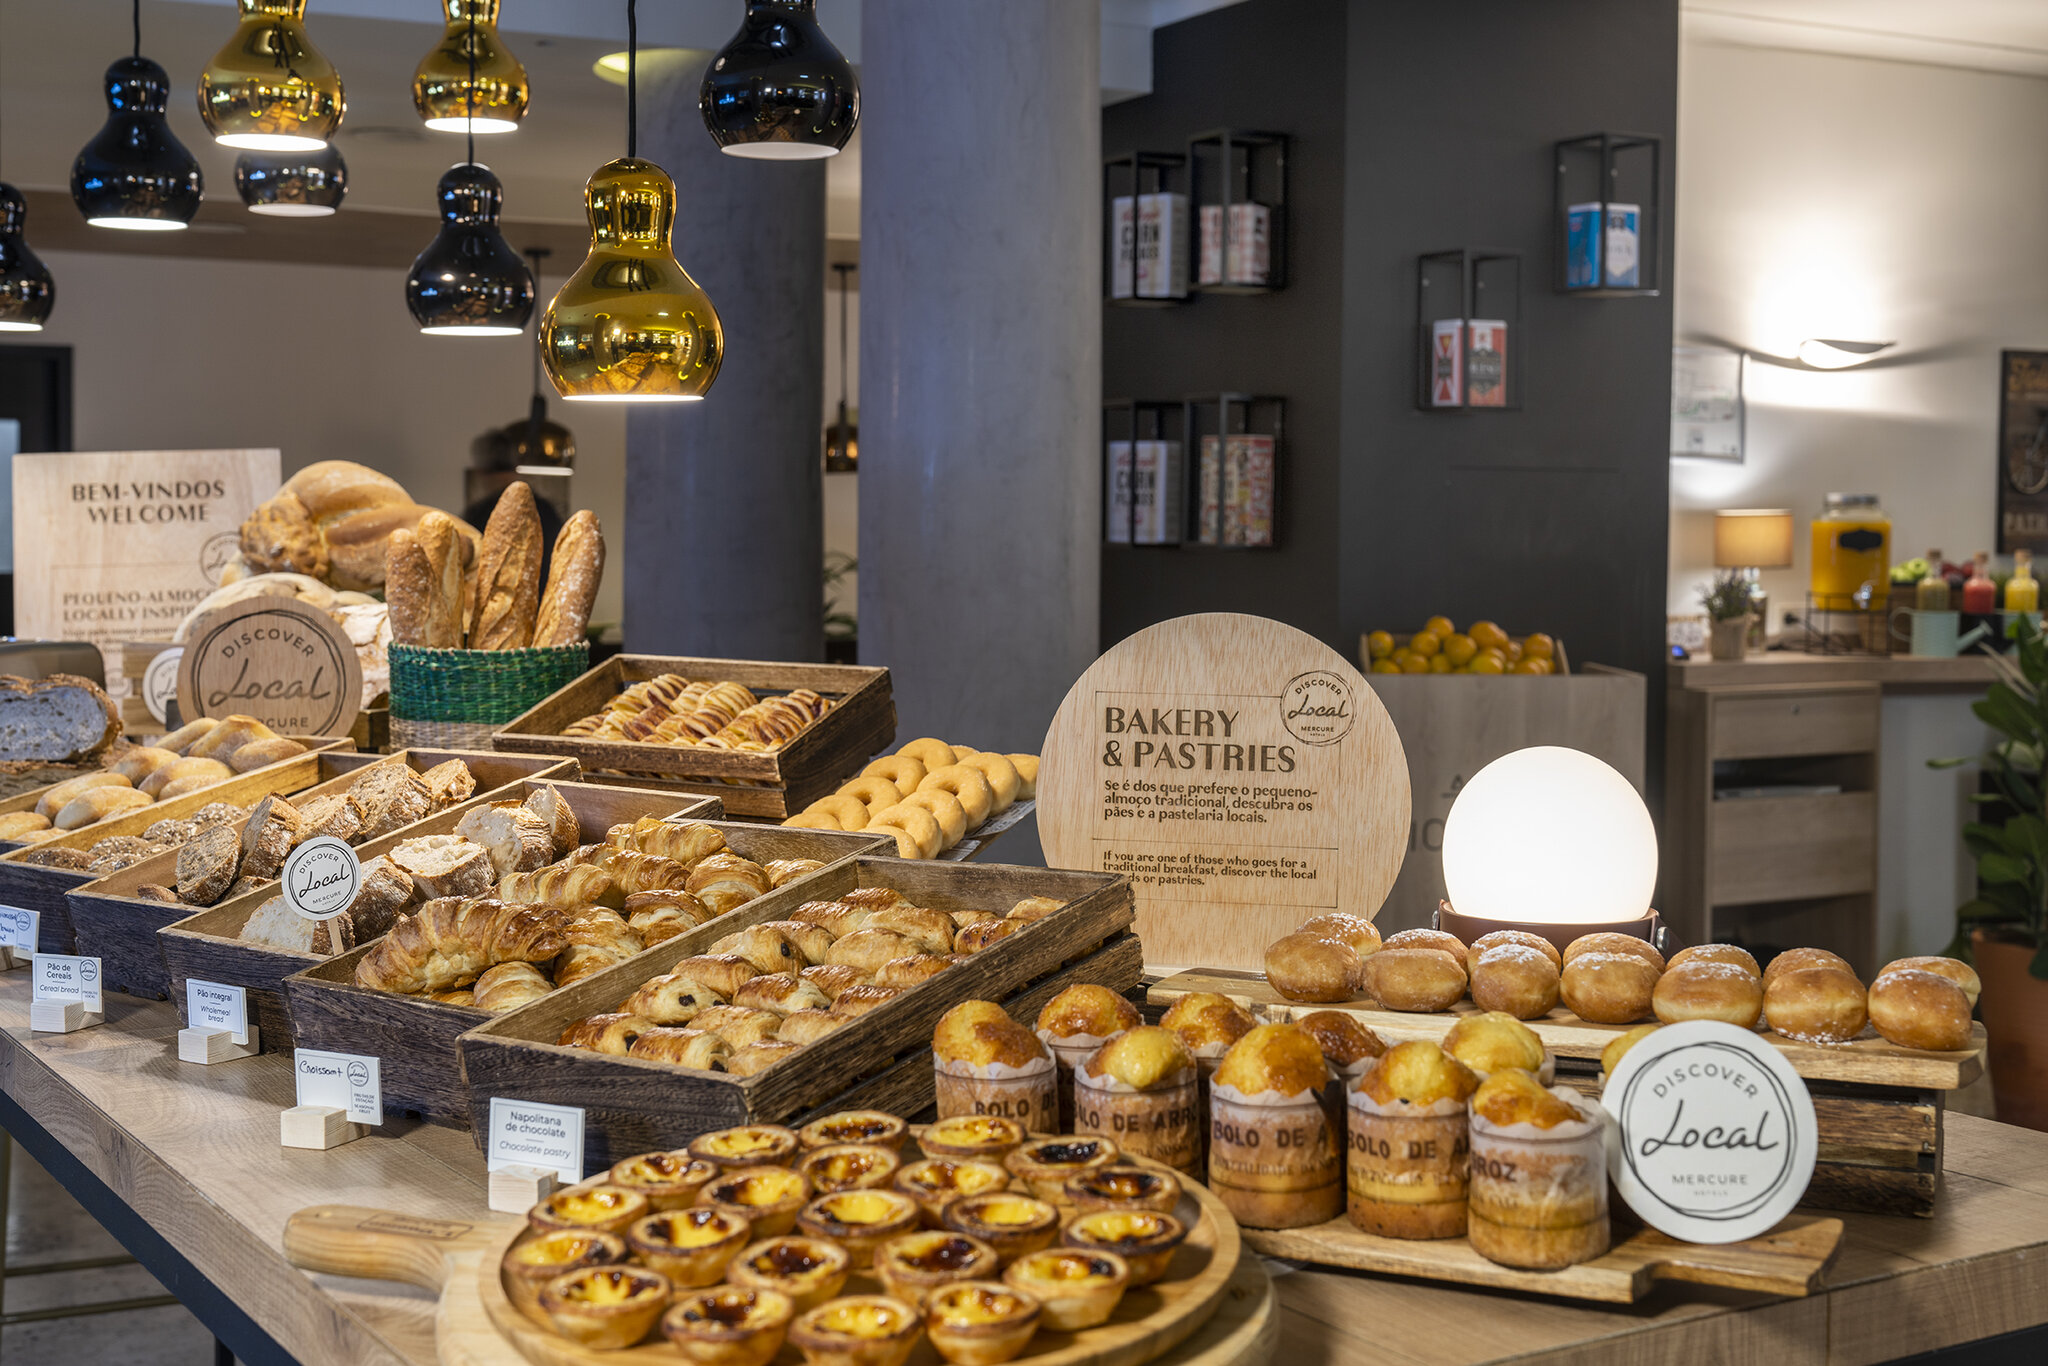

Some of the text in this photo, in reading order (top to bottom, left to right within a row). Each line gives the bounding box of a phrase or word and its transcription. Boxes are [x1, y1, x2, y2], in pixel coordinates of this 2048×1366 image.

[72, 479, 225, 501] BEM-VINDOS
[88, 503, 209, 524] WELCOME
[64, 607, 137, 622] LOCALLY
[221, 628, 315, 659] DISCOVER
[208, 657, 331, 708] Local
[1294, 679, 1342, 696] DISCOVER
[1287, 694, 1349, 720] Local
[1105, 707, 1240, 738] BAKERY
[1102, 740, 1296, 773] & PASTRIES
[1104, 779, 1318, 800] Se é dos que prefere o pequeno-
[1104, 792, 1313, 811] almoço tradicional, descubra os
[1104, 806, 1268, 823] pães e a pastelaria locais.
[299, 852, 339, 875] DISCOVER
[1103, 851, 1307, 869] If you are one of those who goes for a
[1103, 861, 1317, 880] traditional breakfast, discover the local
[1143, 875, 1156, 883] or
[1158, 873, 1205, 887] pastries.
[298, 863, 350, 899] Local
[312, 891, 342, 905] MERCURE
[46, 971, 72, 980] Cereais
[47, 962, 71, 972] Pão de
[39, 984, 80, 994] Cereal bread
[197, 989, 233, 1002] Pão integral
[200, 1005, 231, 1016] Wholemeal
[208, 1014, 224, 1023] bread
[1652, 1063, 1759, 1098] DISCOVER
[510, 1111, 562, 1127] Napolitana
[1112, 1113, 1140, 1132] DE
[1640, 1099, 1779, 1157] Local
[505, 1122, 566, 1138] de chocolate
[1213, 1120, 1260, 1148] BOLO
[1276, 1128, 1305, 1148] DE
[499, 1140, 571, 1160] Chocolate pastry
[1408, 1141, 1437, 1159] DE
[1671, 1174, 1749, 1186] MERCURE
